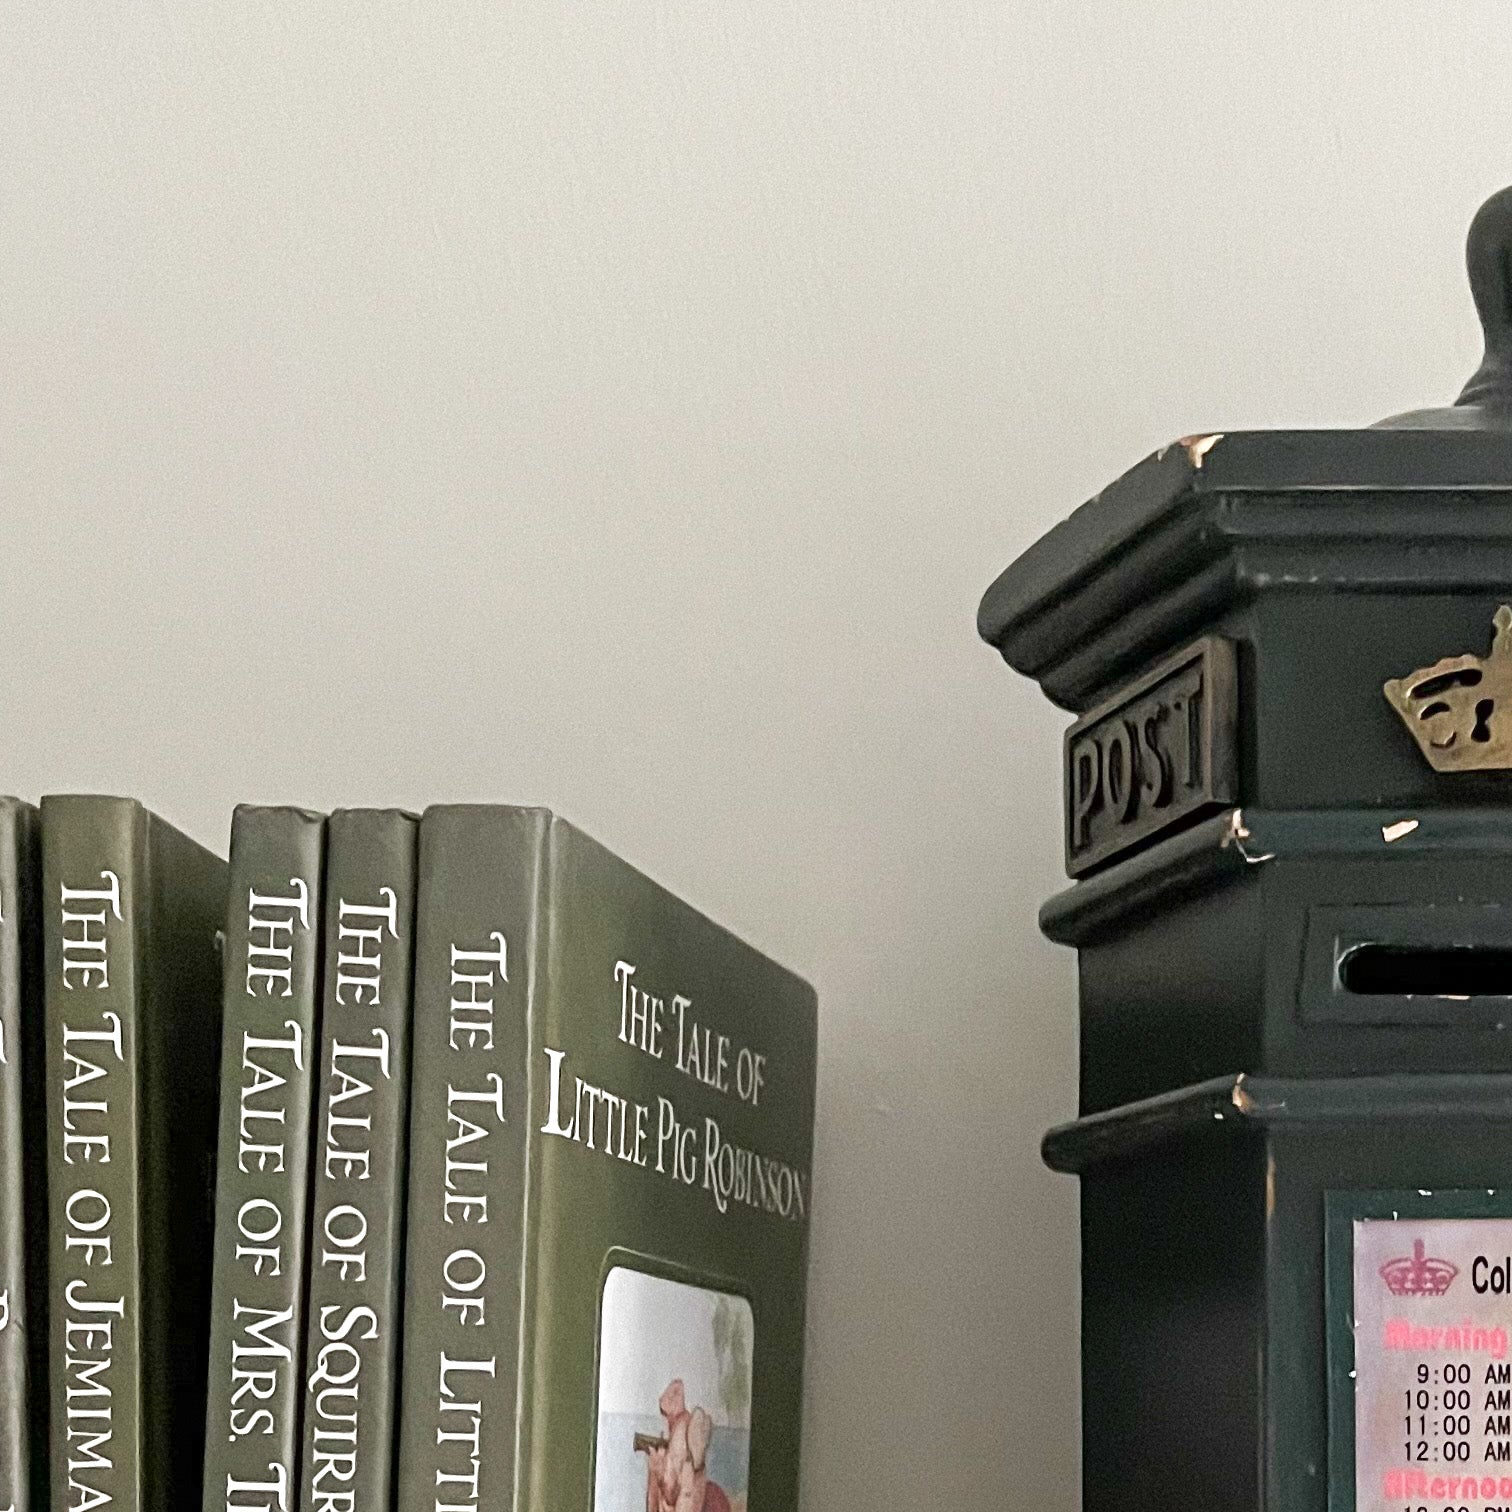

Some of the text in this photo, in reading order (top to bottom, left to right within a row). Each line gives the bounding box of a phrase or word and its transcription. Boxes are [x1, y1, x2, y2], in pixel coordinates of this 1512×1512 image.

[1072, 658, 1204, 850] POST
[61, 871, 123, 990] THE
[247, 878, 310, 998] THE
[336, 886, 400, 1006] THE
[449, 931, 508, 1051] THE
[614, 960, 767, 1105] THE TALE OF
[63, 1012, 124, 1164] TALE
[238, 1020, 304, 1174] TALE
[325, 1028, 391, 1180] TALE
[541, 1047, 808, 1221] LITTLE PIG ROBINSON
[443, 1072, 505, 1225] TALE
[66, 1189, 113, 1265] OF
[235, 1198, 282, 1276] OF
[322, 1205, 367, 1282] OF
[442, 1249, 486, 1326] OF
[1384, 1317, 1508, 1360] Morning
[229, 1298, 294, 1442] MRS.
[1405, 1389, 1511, 1411] 10:00 AM
[1405, 1415, 1511, 1436] 11:00 AM
[1417, 1363, 1511, 1385] 9:00 AM
[1405, 1441, 1511, 1462] 12:00 AM
